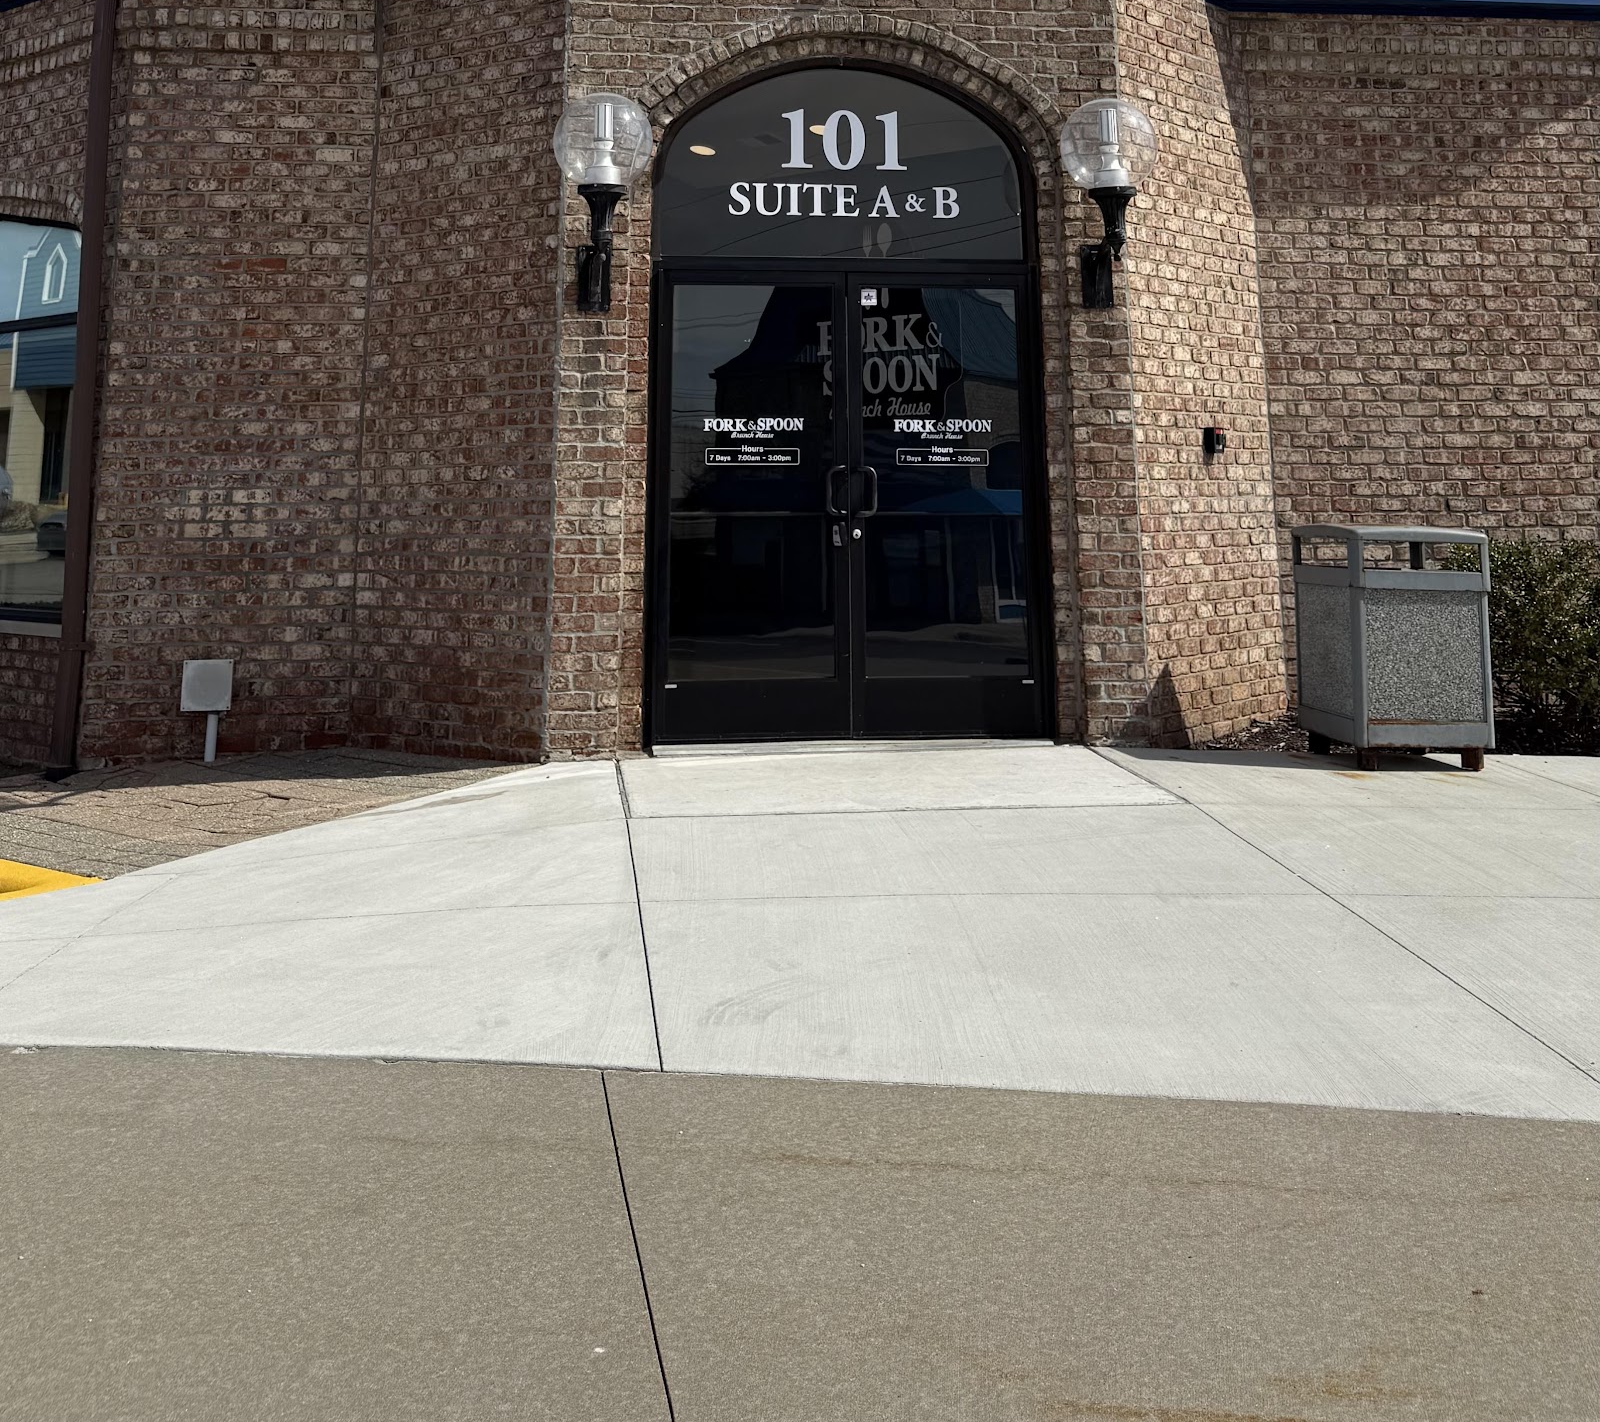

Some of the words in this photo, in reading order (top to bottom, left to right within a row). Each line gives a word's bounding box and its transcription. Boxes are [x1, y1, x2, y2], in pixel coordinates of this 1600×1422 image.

[781, 108, 907, 171] 101
[728, 181, 860, 217] SUITE
[868, 185, 900, 218] A
[904, 193, 926, 212] &
[932, 186, 960, 219] B
[816, 313, 924, 356] FRK
[886, 396, 931, 417] House
[703, 418, 747, 432] FORK
[756, 417, 804, 431] SPOON
[893, 419, 937, 433] FORK
[945, 419, 992, 433] SPOON
[741, 444, 764, 453] Hours
[931, 445, 953, 454] Hours
[715, 454, 731, 462] Days
[767, 454, 791, 462] 3:00pm
[906, 455, 922, 463] Days
